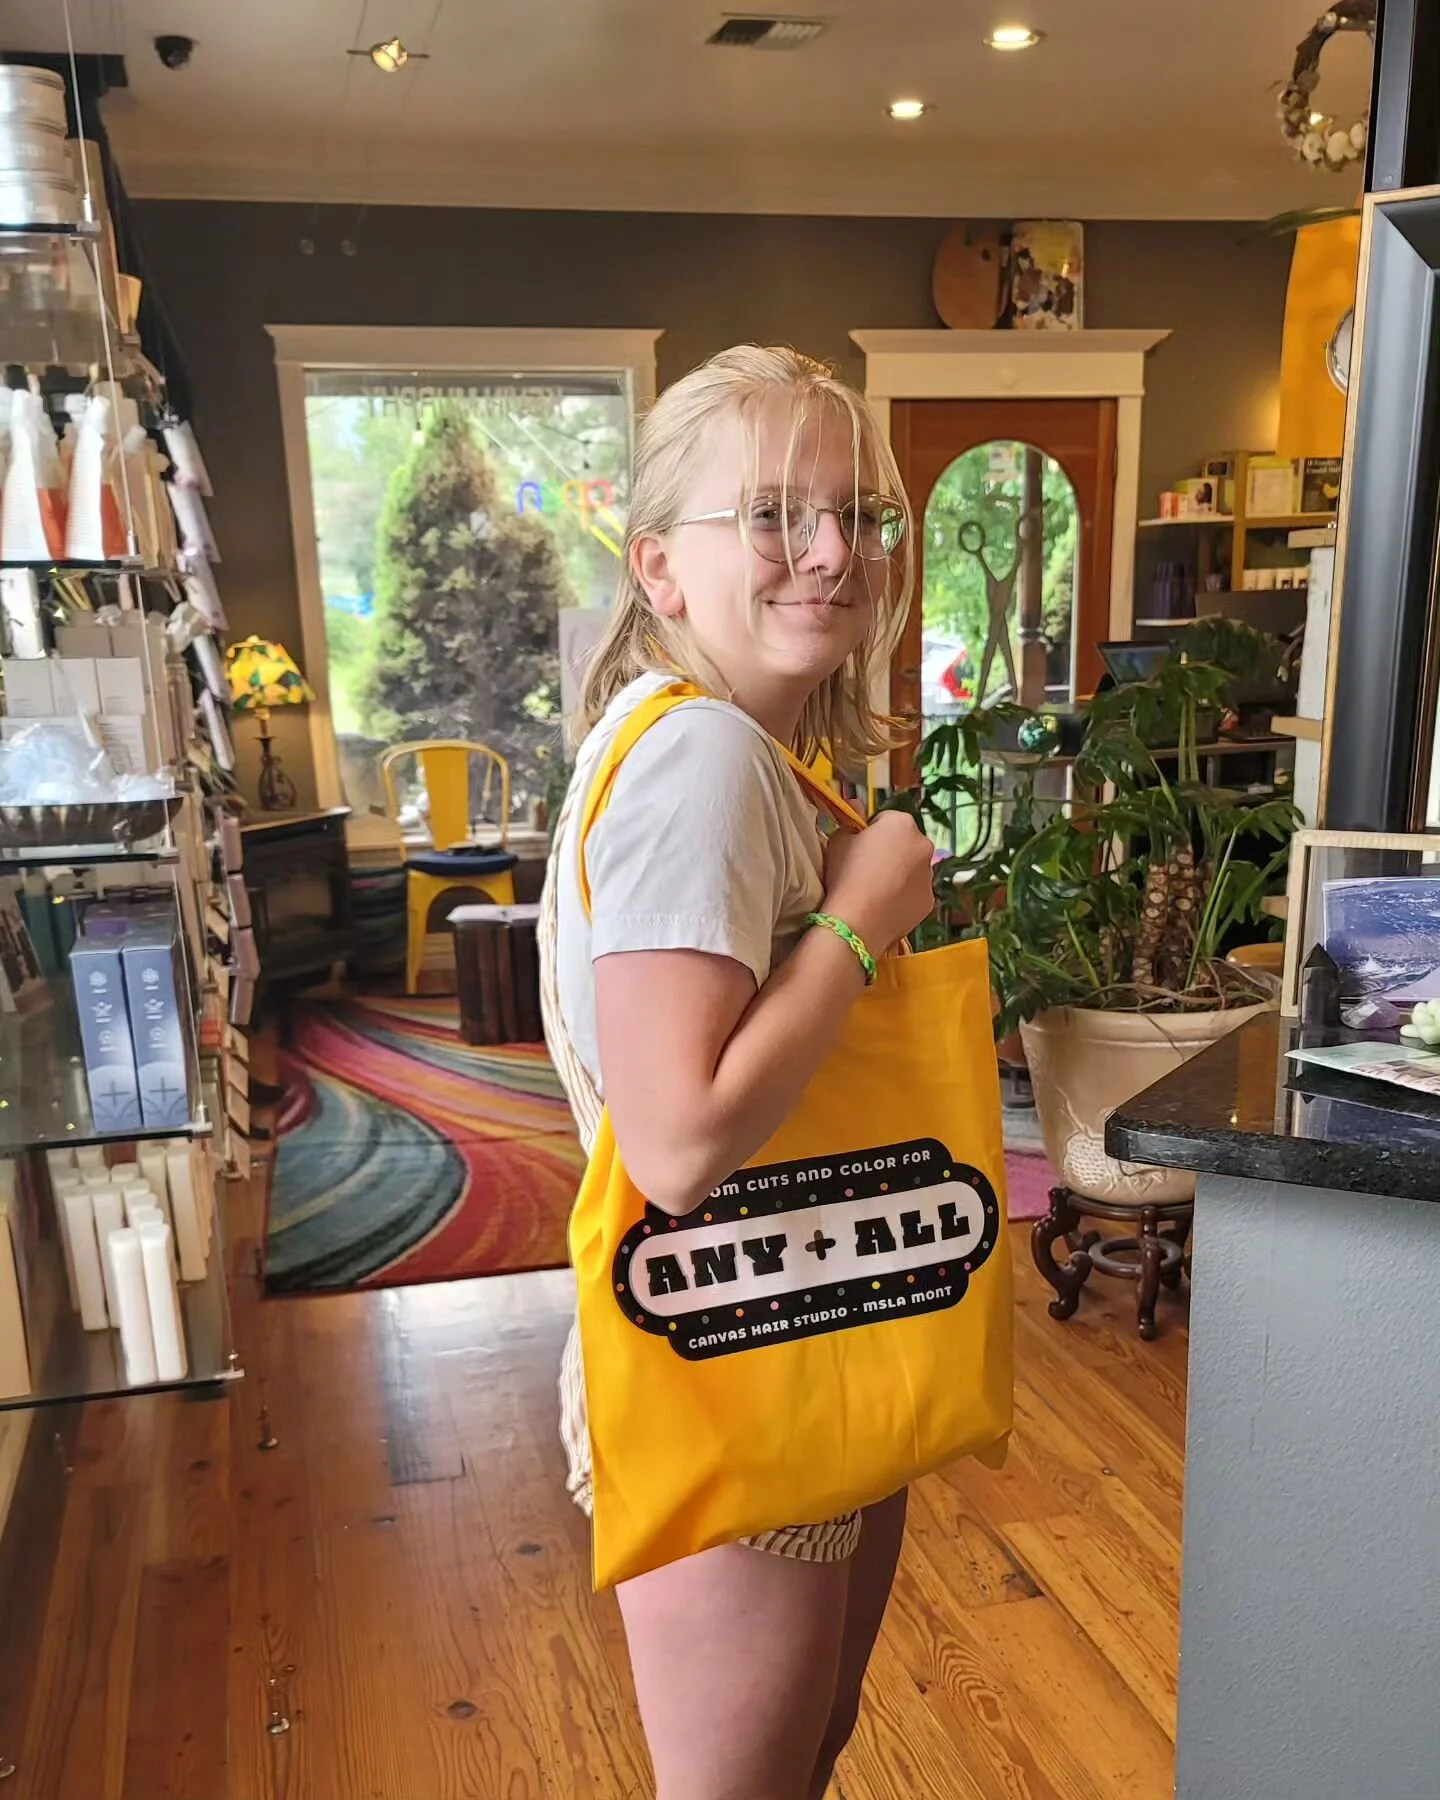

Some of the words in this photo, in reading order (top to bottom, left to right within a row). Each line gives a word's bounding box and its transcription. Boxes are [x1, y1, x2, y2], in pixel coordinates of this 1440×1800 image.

[746, 1174, 790, 1192] CUTS
[796, 1167, 833, 1184] AND
[839, 1156, 896, 1177] COLOR
[902, 1149, 931, 1166] FOR
[646, 1233, 788, 1297] ANY
[854, 1201, 971, 1257] ALL
[688, 1327, 747, 1350] CANVAS
[751, 1319, 789, 1337] HAIR
[793, 1306, 848, 1328] STUDIO
[863, 1295, 906, 1313] MSLA
[911, 1285, 953, 1304] MONT
